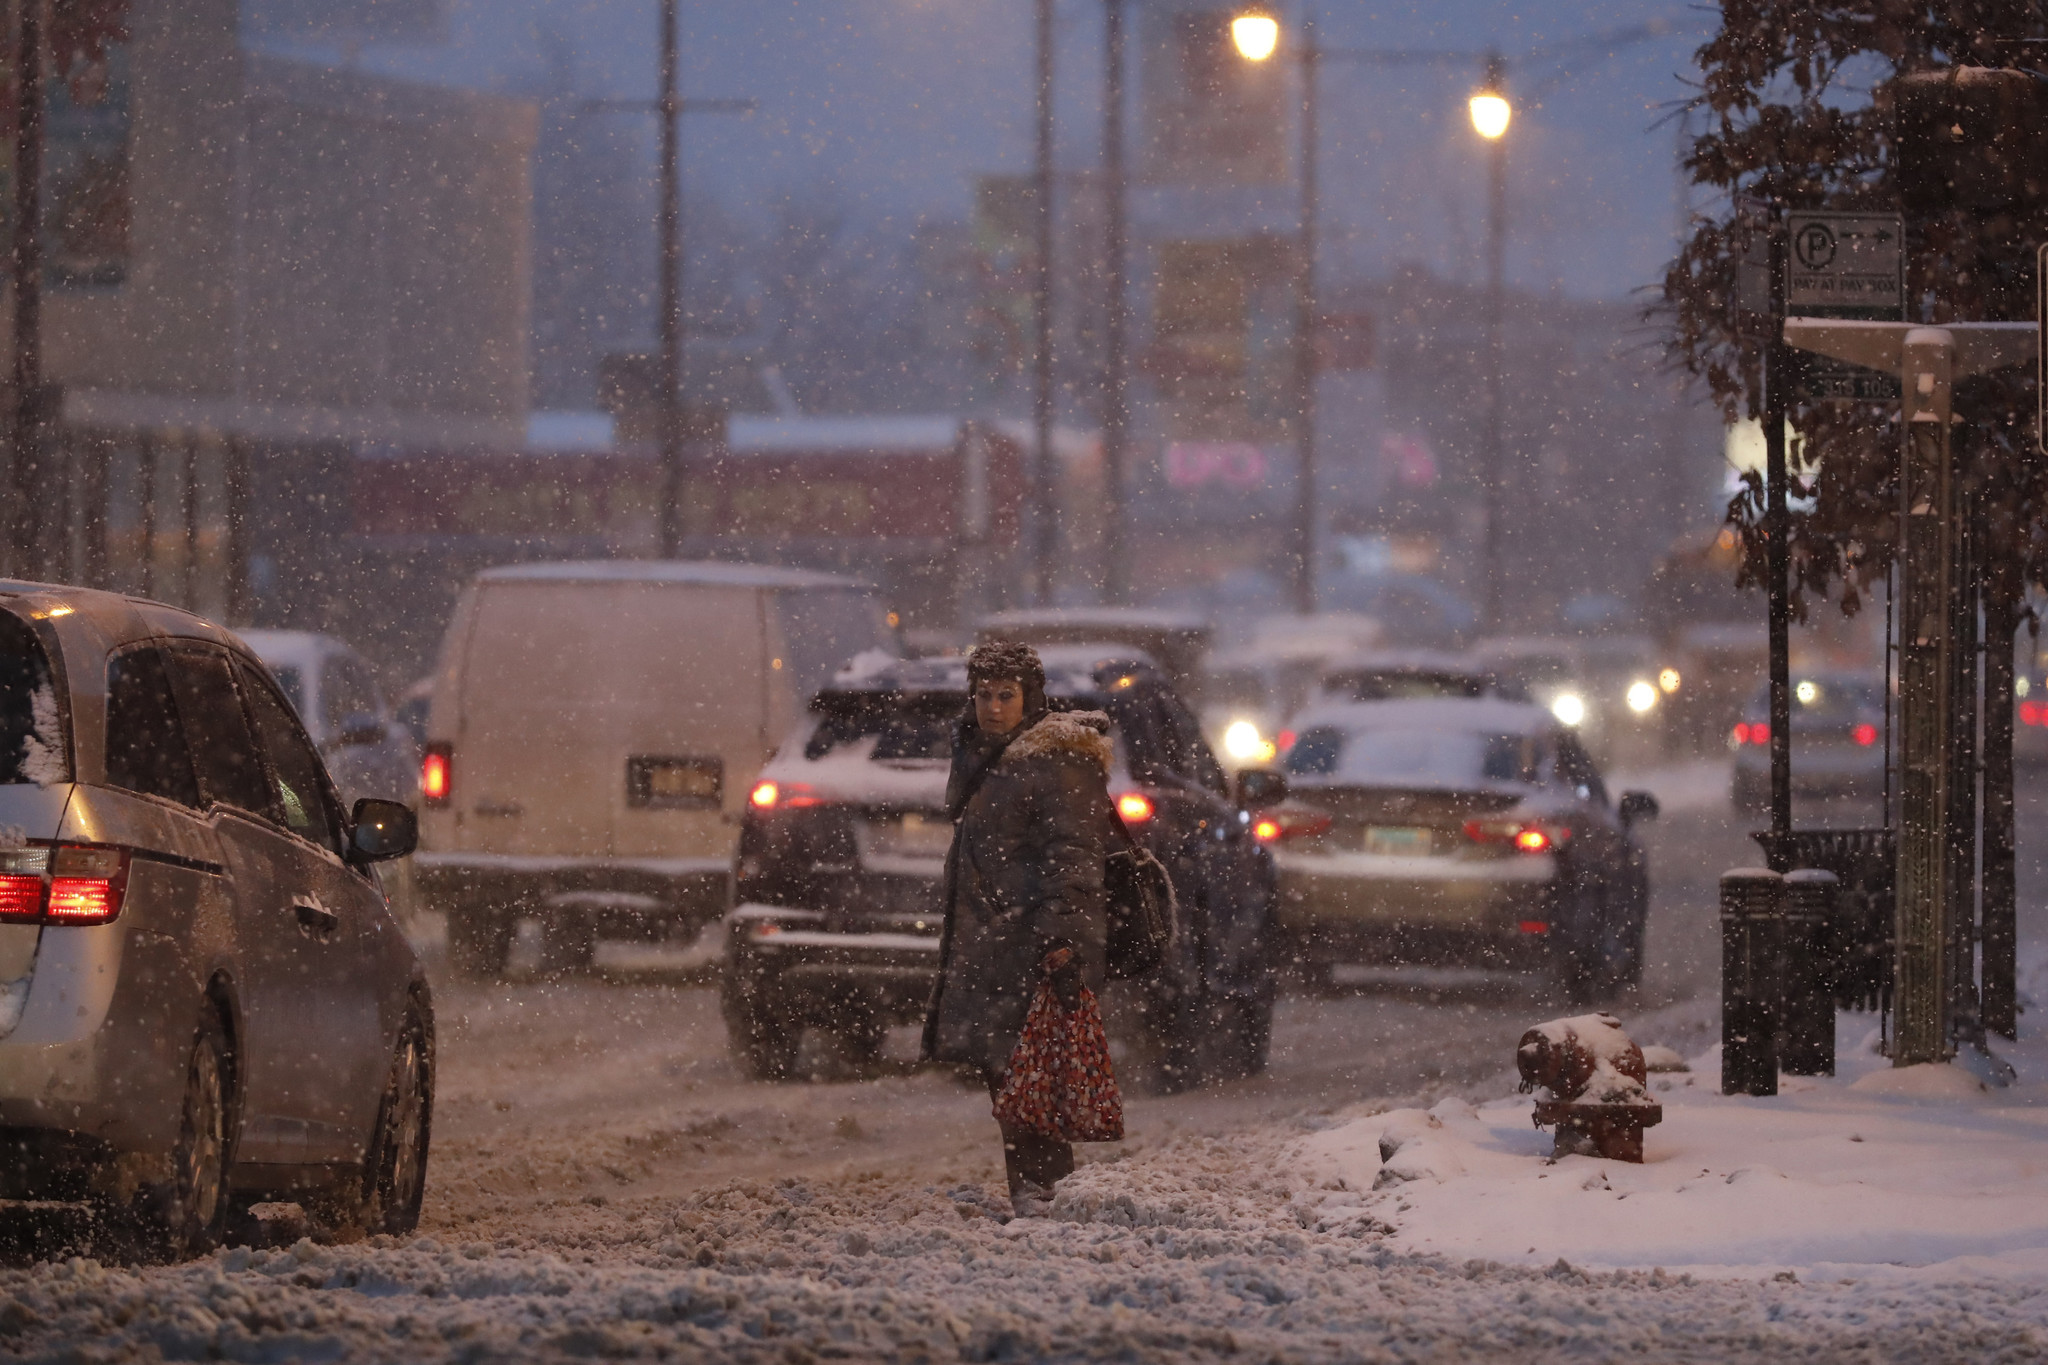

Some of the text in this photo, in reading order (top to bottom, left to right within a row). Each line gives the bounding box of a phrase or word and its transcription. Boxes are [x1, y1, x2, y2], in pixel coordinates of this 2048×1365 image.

[1794, 278, 1896, 293] PAY AT PAY BOX
